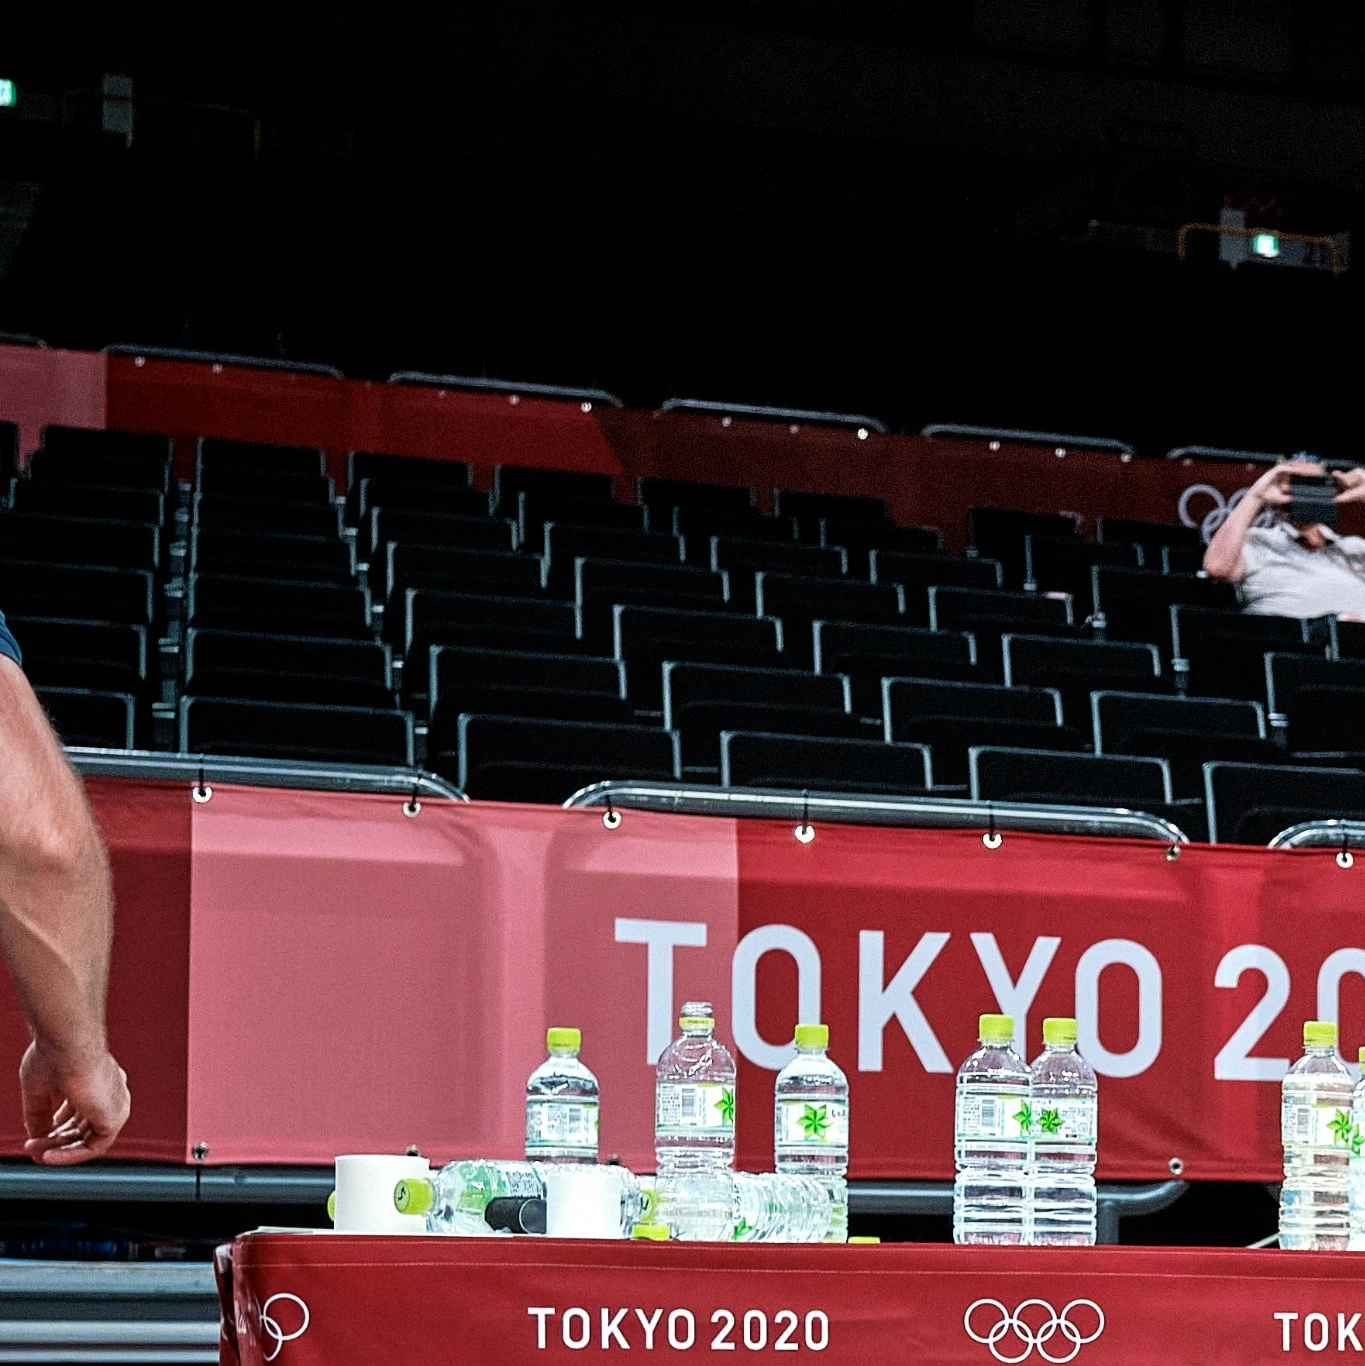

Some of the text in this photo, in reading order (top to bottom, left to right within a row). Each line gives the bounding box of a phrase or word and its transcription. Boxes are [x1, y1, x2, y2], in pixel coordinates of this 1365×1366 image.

[614, 917, 1163, 1079] TOKYO
[528, 1306, 830, 1351] TOKYO 2020
